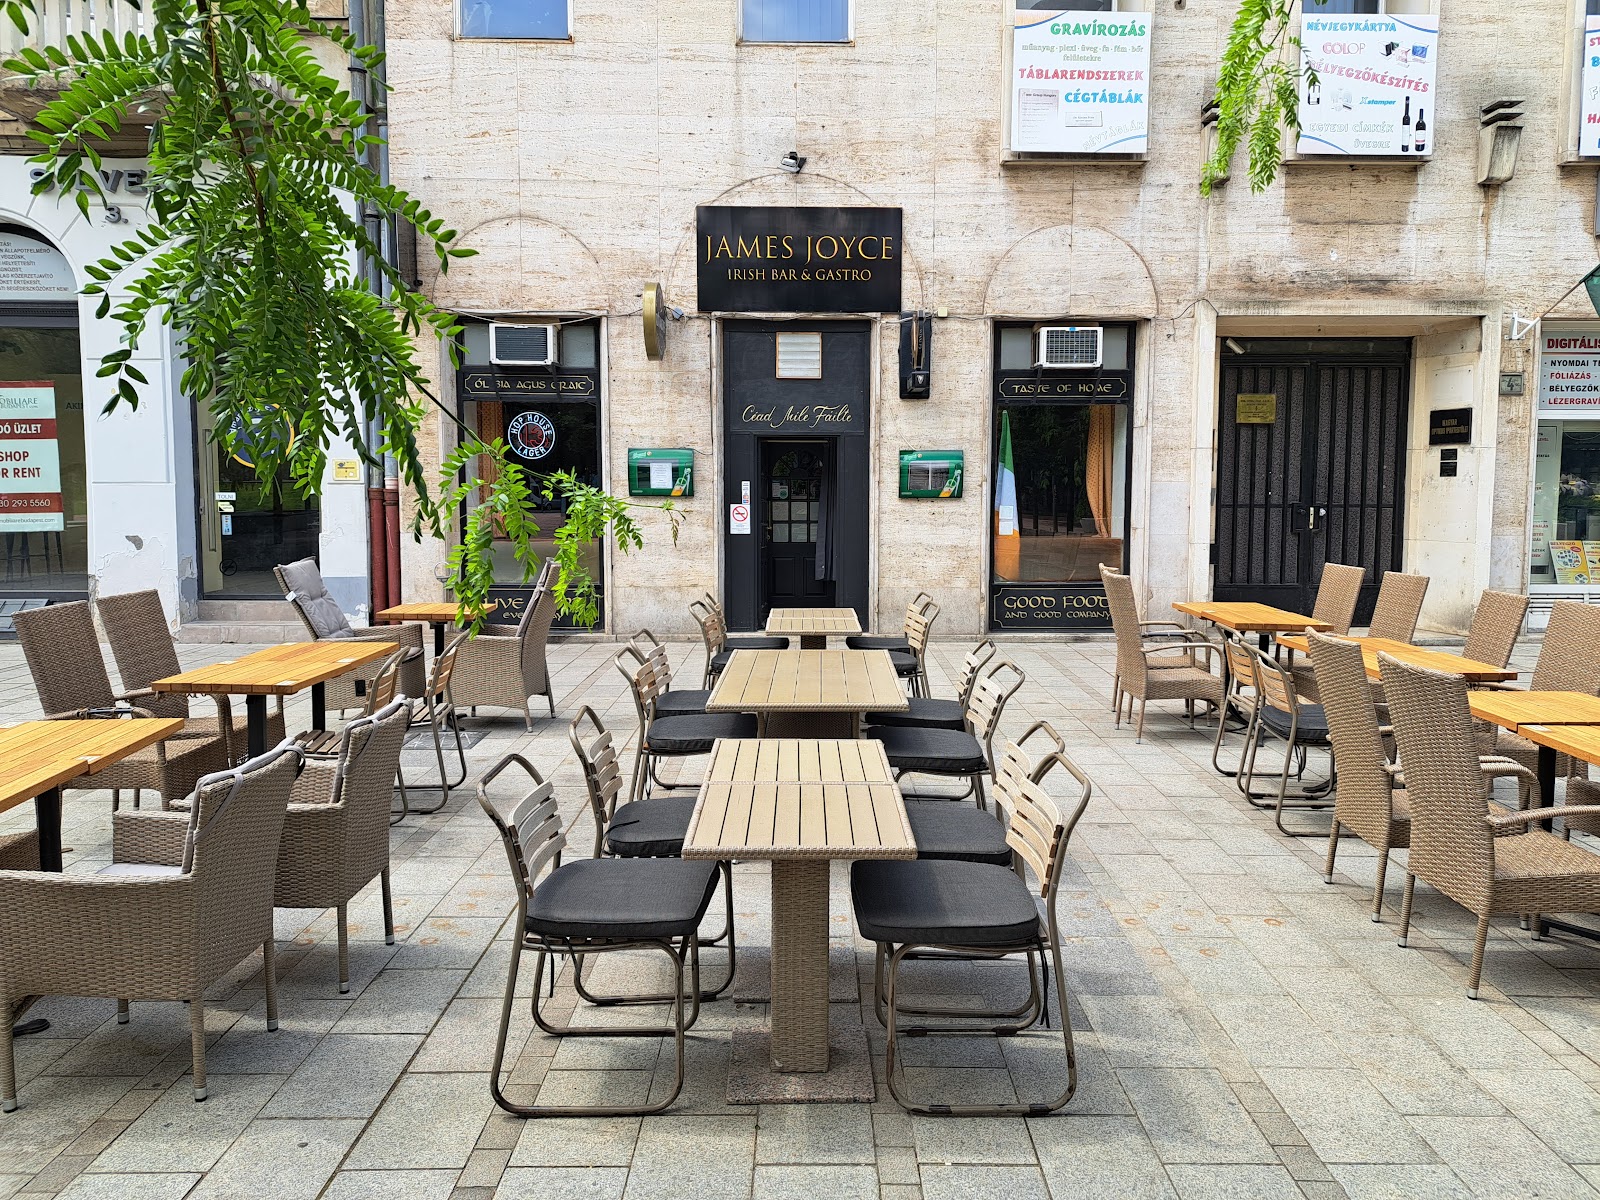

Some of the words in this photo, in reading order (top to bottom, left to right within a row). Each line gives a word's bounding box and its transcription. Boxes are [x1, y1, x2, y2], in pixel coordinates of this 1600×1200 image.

[1050, 19, 1146, 36] GRAVÍROZÁS
[1307, 19, 1397, 32] NÉVJEGYKÁRTYA
[1059, 44, 1077, 53] plexi
[1081, 44, 1099, 53] üveg
[1102, 44, 1110, 52] fa
[1114, 44, 1127, 52] fém
[1322, 42, 1366, 55] COLOP
[1019, 65, 1144, 81] TÁBLARENDSZEREK
[1308, 58, 1430, 93] BÉLYEGZŐKÉSZÍTÉS
[1064, 88, 1143, 104] CÉGTÁBLÁK
[1309, 122, 1349, 133] EGYEDI
[1352, 121, 1394, 133] CÍMKÉK
[29, 168, 167, 195] SLVE
[705, 235, 794, 264] JAMES
[805, 235, 894, 265] JOYCE
[727, 268, 766, 281] IRISH
[771, 268, 798, 281] BAR
[801, 269, 811, 281] &
[815, 268, 872, 281] GASTRO
[1547, 336, 1600, 349] DIGITÁLIS
[1550, 371, 1591, 379] FÓLIÁZÁS
[474, 378, 489, 388] ÓL
[516, 381, 546, 390] AGUS
[1012, 384, 1050, 393] TASTE
[1057, 384, 1072, 393] OF
[1549, 384, 1599, 392] BÉLYEGZŐK
[14, 422, 41, 433] ÜZLET
[511, 417, 524, 434] HOP
[527, 414, 552, 435] HOUSE
[0, 451, 29, 461] SHOP
[518, 446, 546, 457] LAGER
[13, 467, 41, 478] RENT
[30, 499, 51, 507] 5560
[1004, 595, 1056, 609] GOOD
[1063, 595, 1109, 609] FOOD
[1005, 610, 1027, 618] AND
[1034, 610, 1062, 619] GOOD
[1067, 610, 1111, 620] COMPANY
